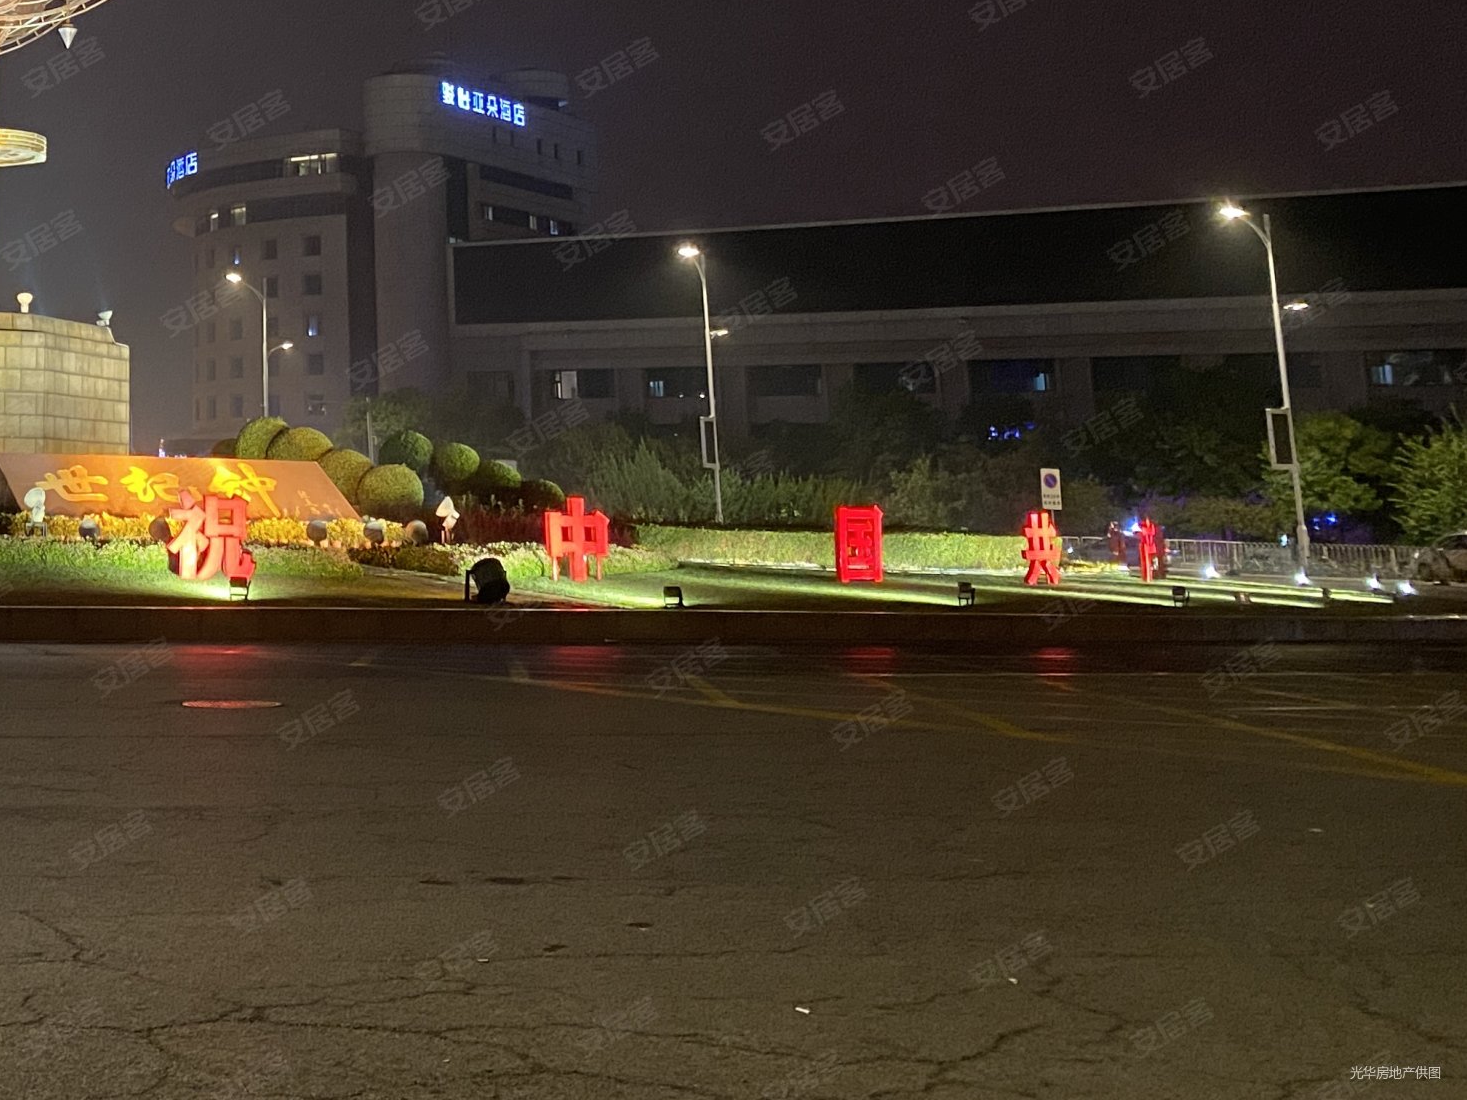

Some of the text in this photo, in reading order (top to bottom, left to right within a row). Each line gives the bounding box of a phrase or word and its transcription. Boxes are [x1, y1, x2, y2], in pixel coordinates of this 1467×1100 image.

[167, 488, 258, 580] 祝
[544, 496, 610, 582] 中
[835, 504, 883, 583] 国
[1021, 511, 1062, 587] 共
